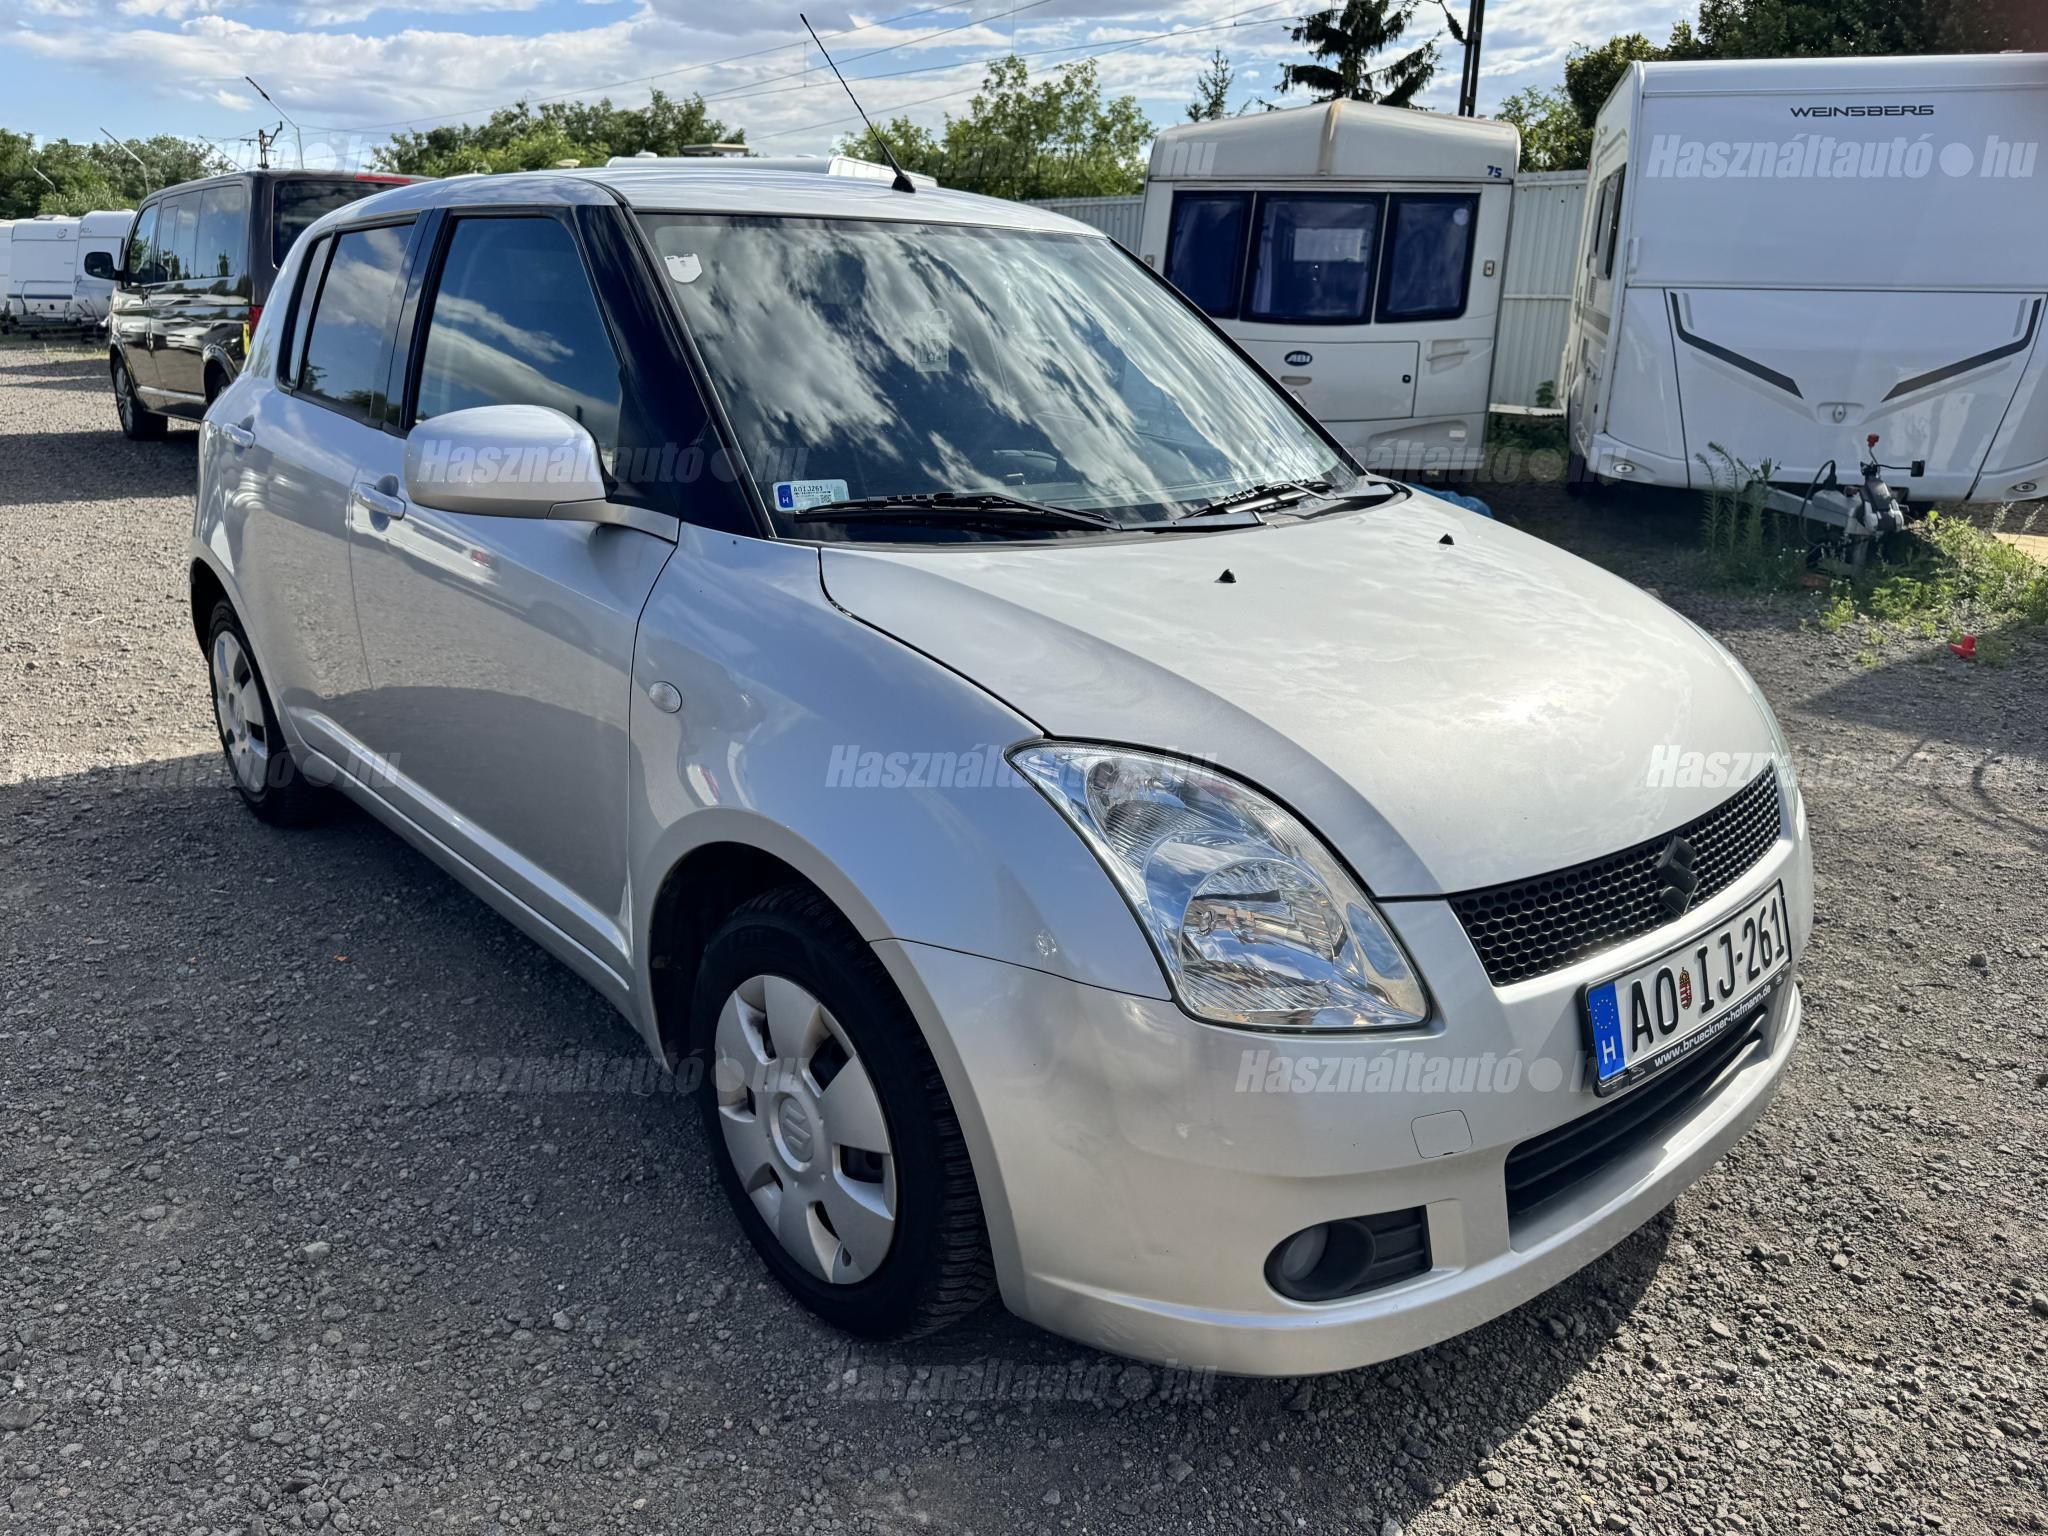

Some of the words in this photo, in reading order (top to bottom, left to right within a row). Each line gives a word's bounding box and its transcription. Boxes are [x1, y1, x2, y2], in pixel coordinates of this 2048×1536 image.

[1790, 104, 1935, 118] WEINSBERG
[1487, 165, 1503, 179] 75
[1654, 985, 1771, 1067] www.brueckner-hofmann.de
[1602, 1036, 1617, 1064] H
